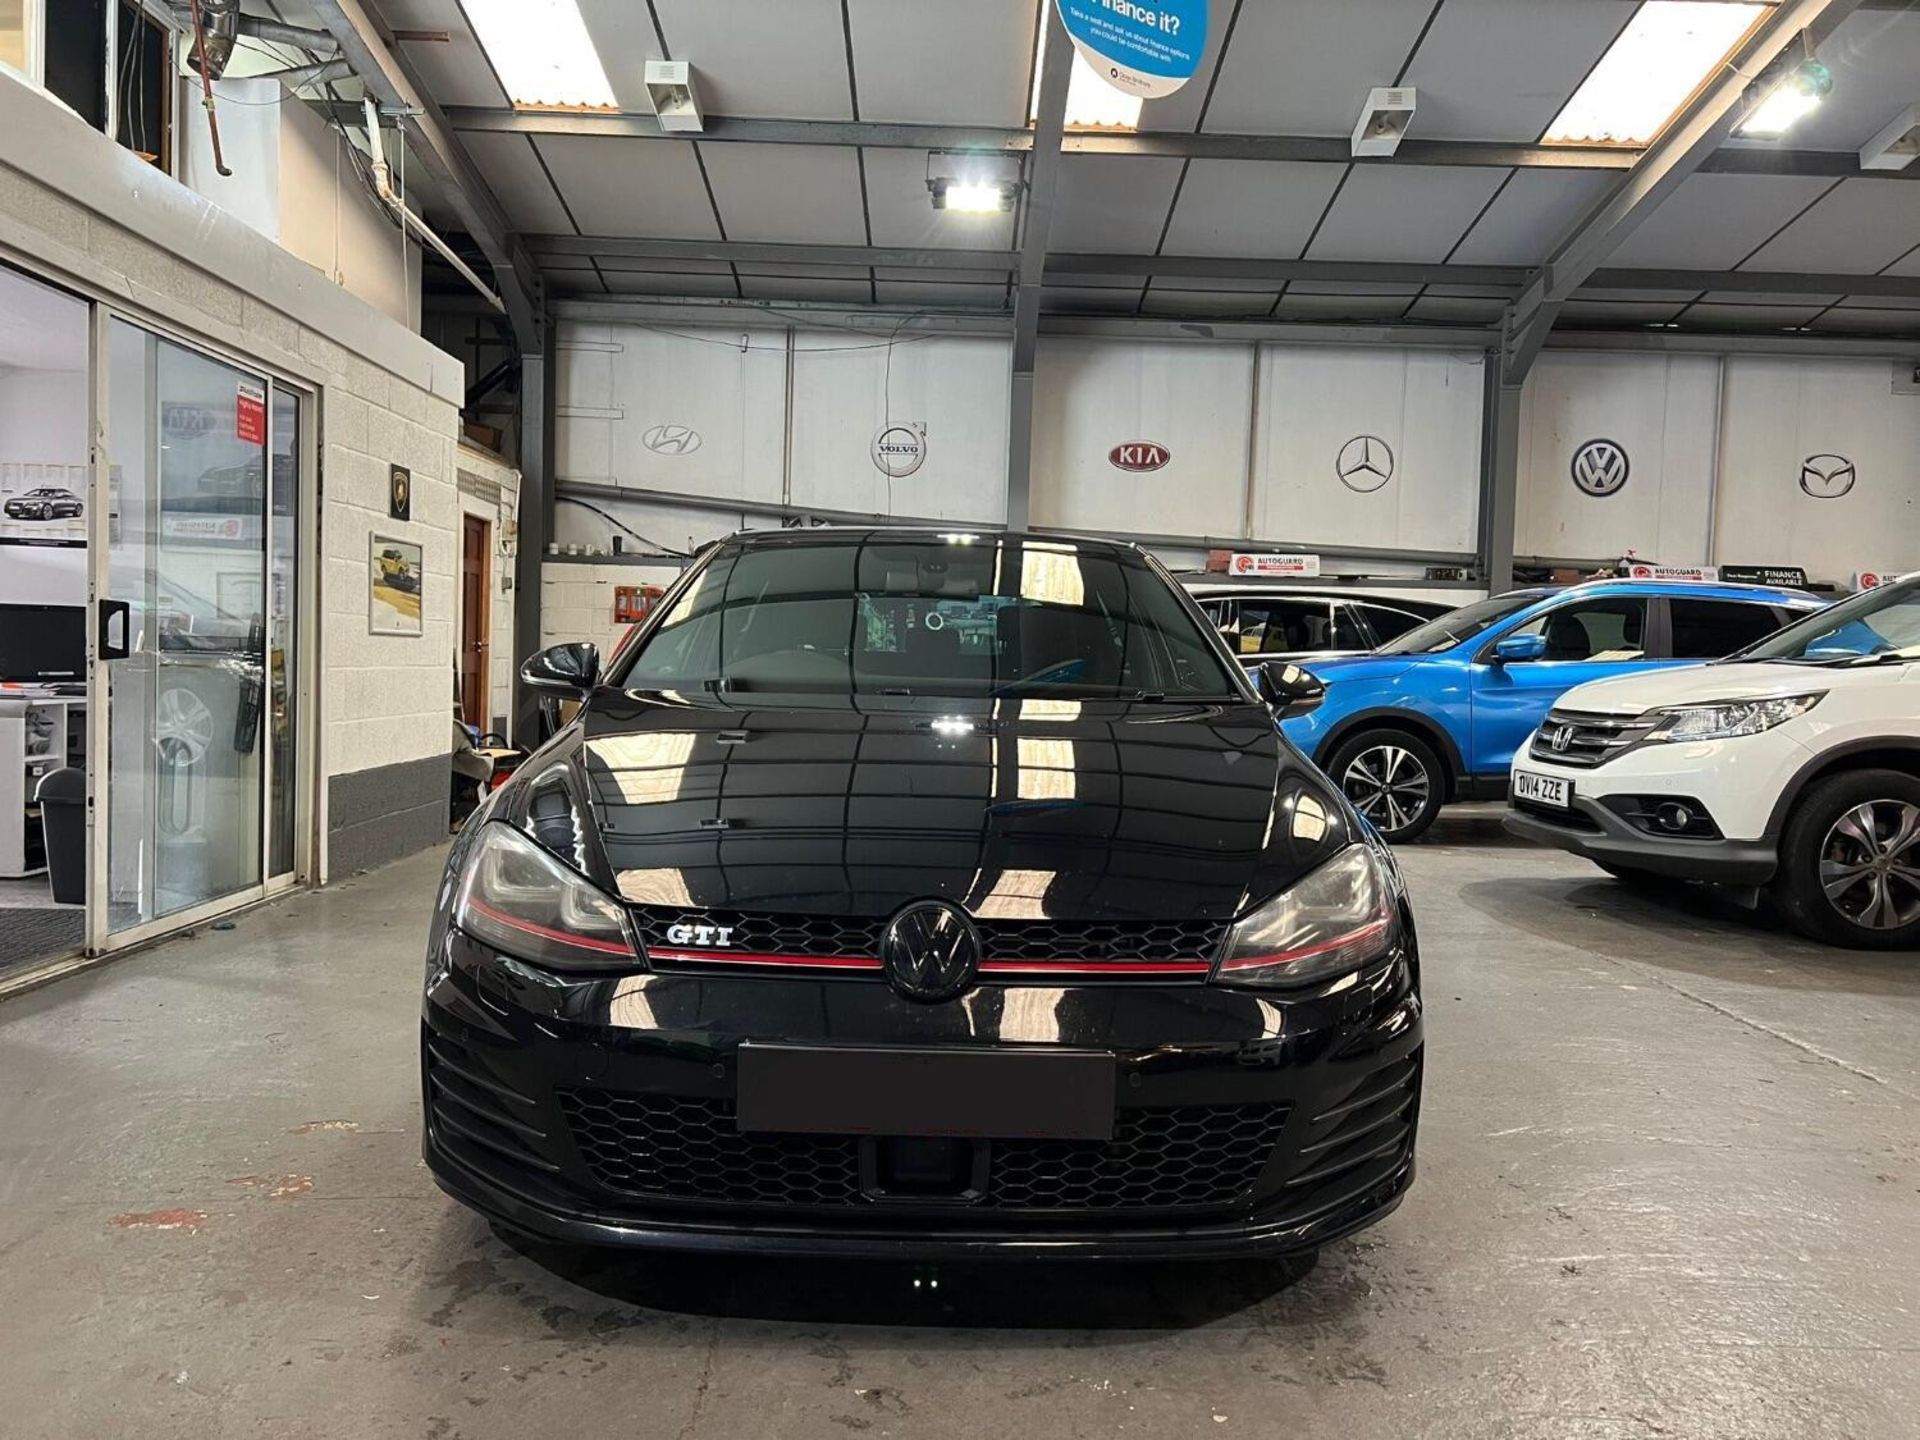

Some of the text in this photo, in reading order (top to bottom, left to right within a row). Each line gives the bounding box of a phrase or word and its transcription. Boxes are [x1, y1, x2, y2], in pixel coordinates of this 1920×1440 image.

[1160, 11, 1180, 36] it?
[1120, 447, 1160, 464] KIA
[1258, 557, 1303, 565] AUTOGUARD
[1655, 568, 1702, 576] AUTOGUARD
[1764, 570, 1802, 579] FINANCE
[1766, 578, 1803, 586] AVAILABLE
[1542, 779, 1562, 802] ZZE
[667, 924, 733, 946] GTI
